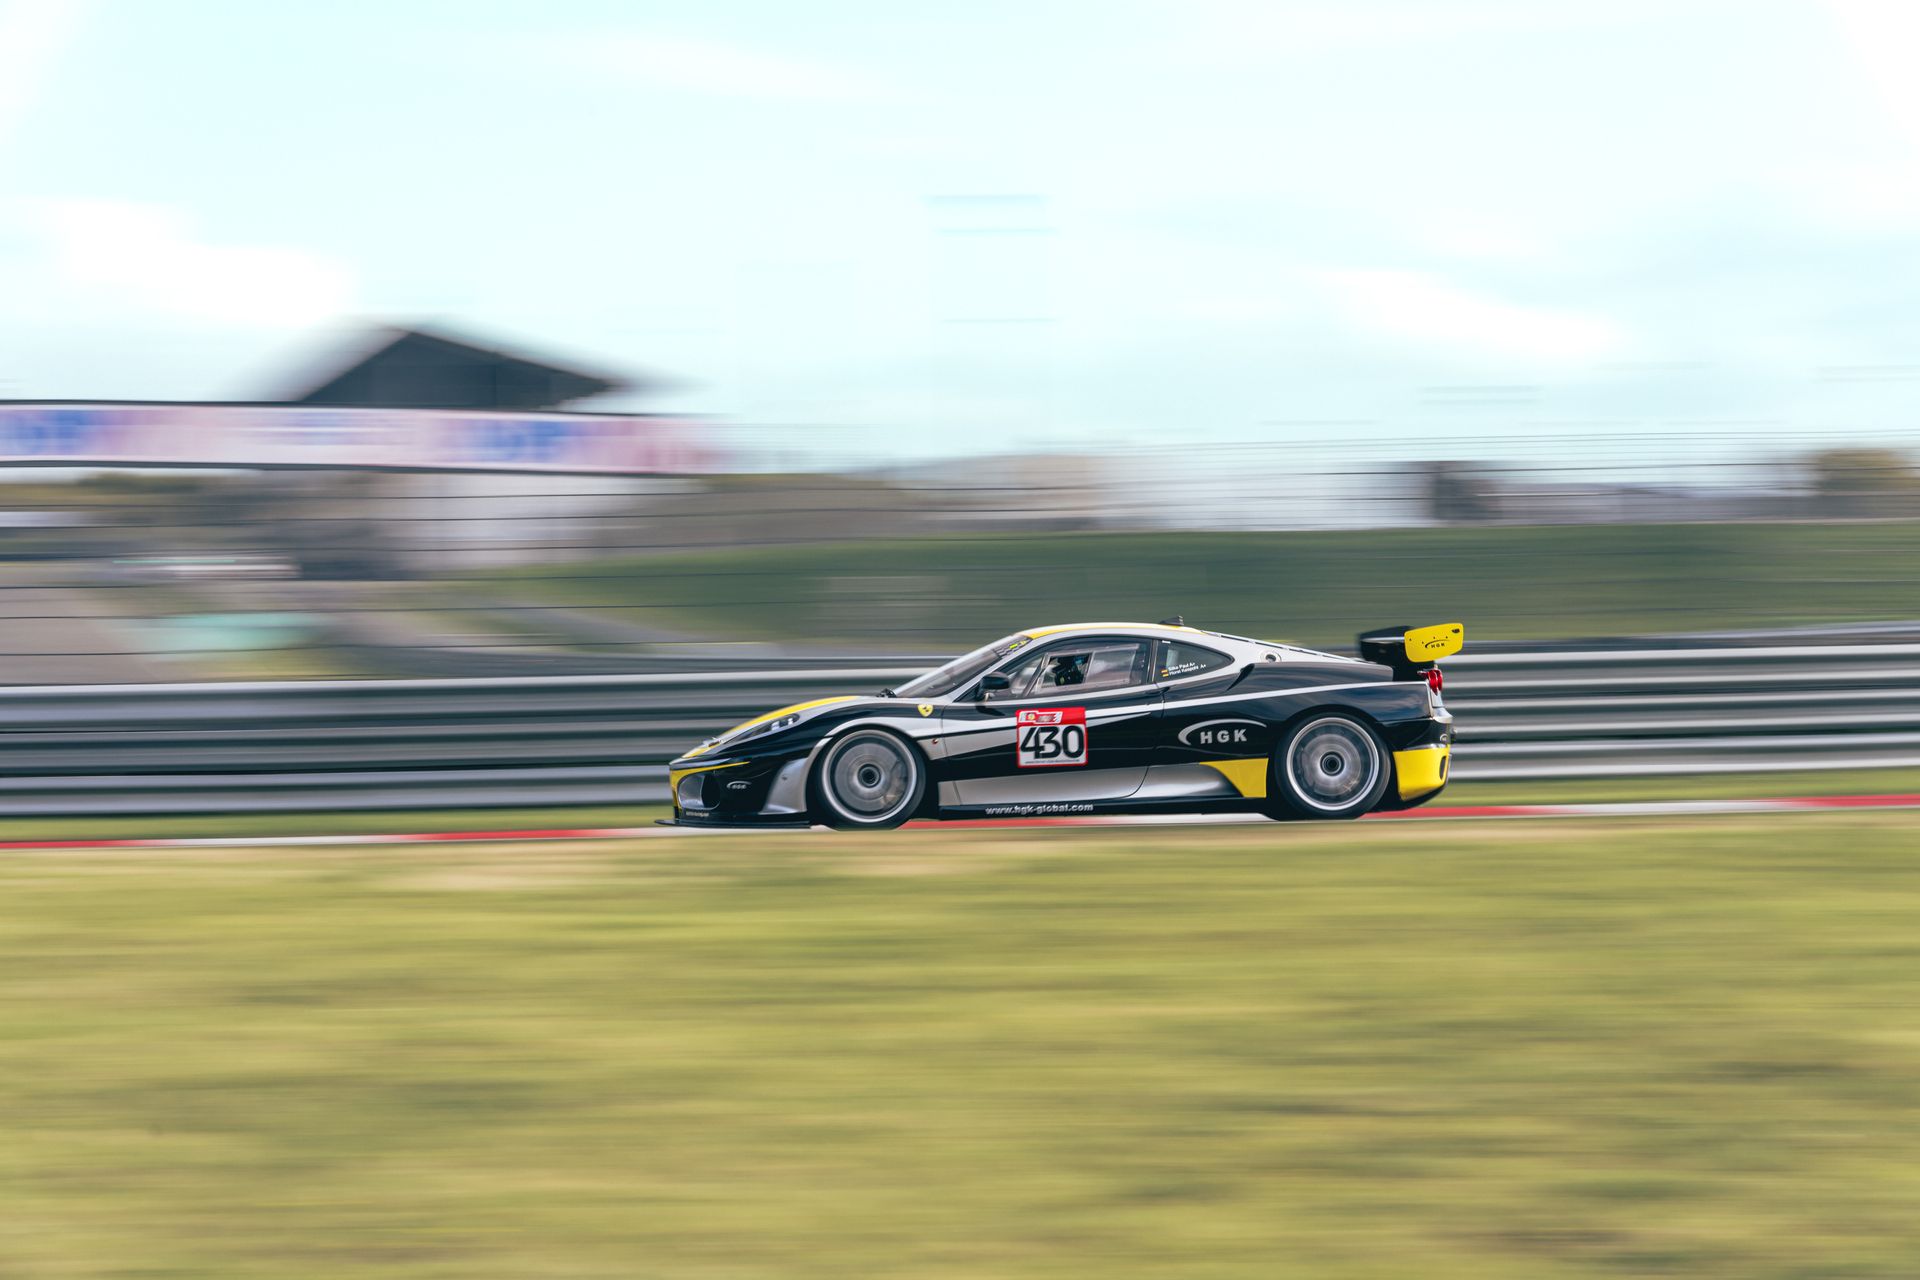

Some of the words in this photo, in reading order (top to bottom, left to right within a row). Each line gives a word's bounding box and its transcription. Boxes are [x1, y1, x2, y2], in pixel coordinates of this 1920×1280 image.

[1020, 725, 1084, 759] 430
[1200, 728, 1248, 745] HGK
[985, 804, 1093, 814] www.hgk-global.com
